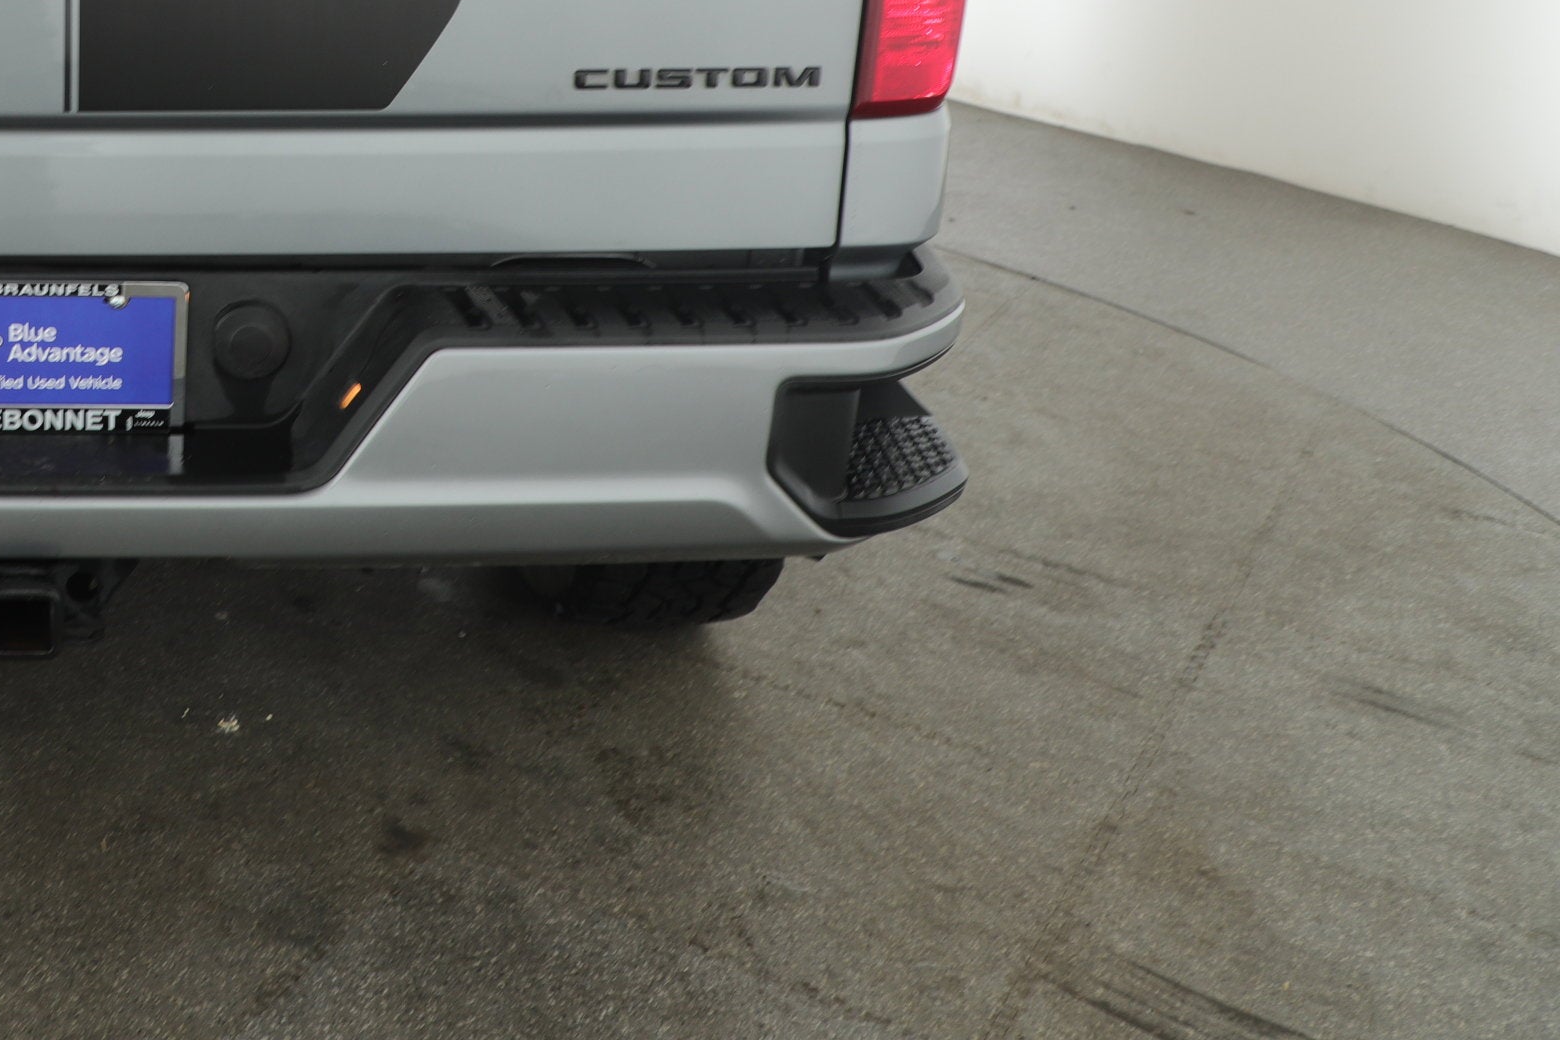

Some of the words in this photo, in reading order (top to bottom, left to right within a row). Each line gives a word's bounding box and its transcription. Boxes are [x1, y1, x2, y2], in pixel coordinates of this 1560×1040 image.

[574, 66, 822, 90] CUSTOM
[8, 322, 57, 343] Blue
[7, 343, 124, 366] Advantage
[27, 375, 66, 390] Used
[69, 375, 123, 390] Vehicle
